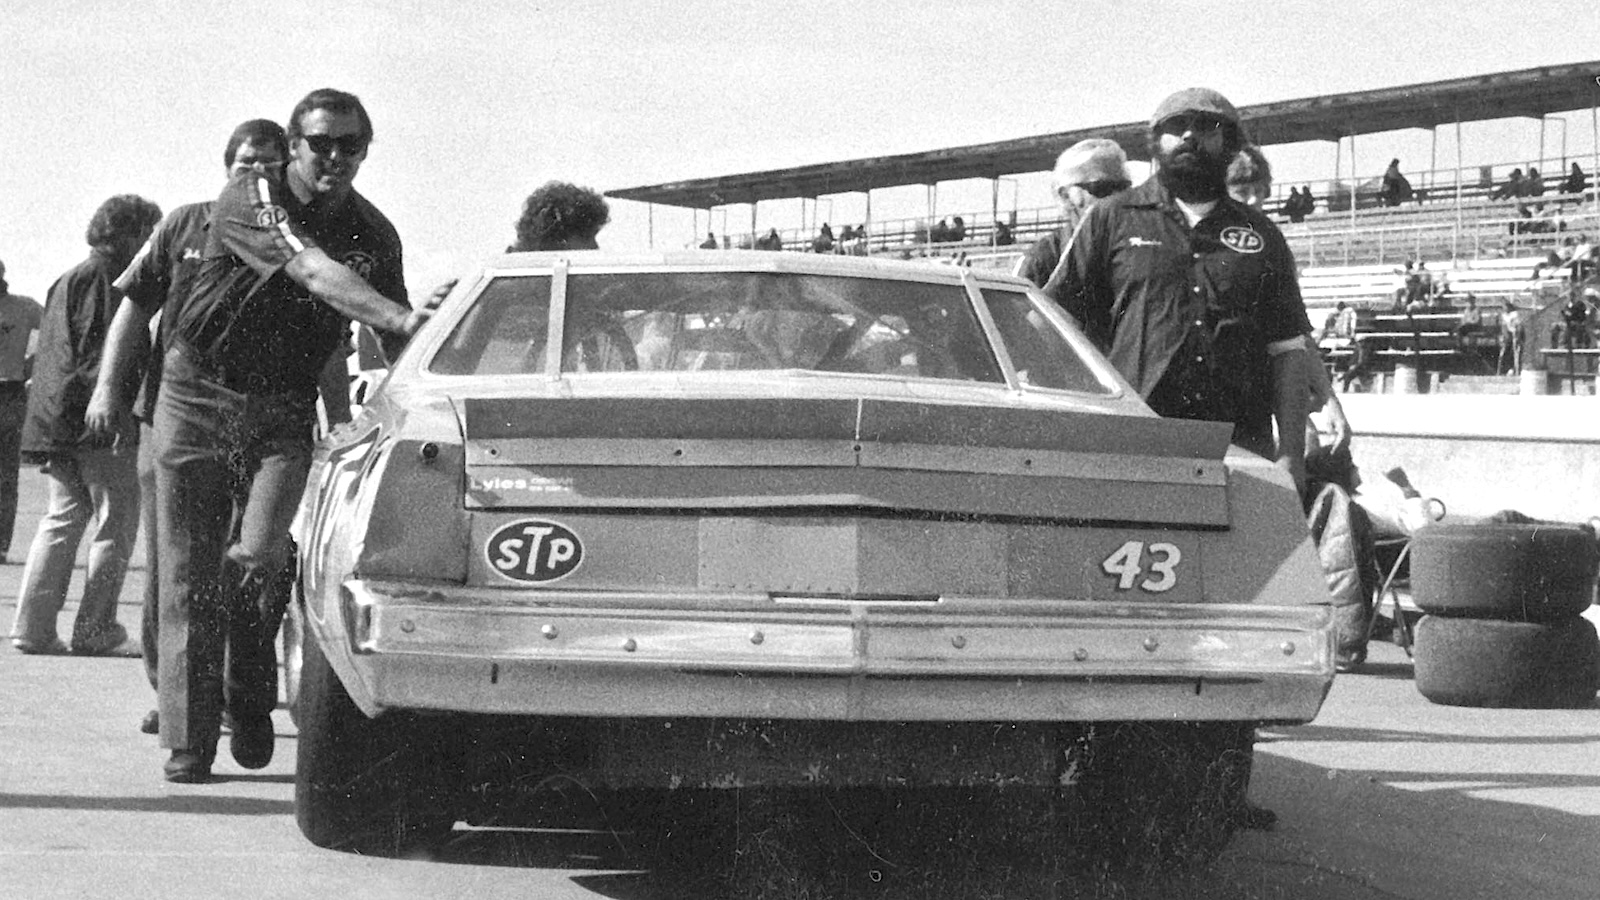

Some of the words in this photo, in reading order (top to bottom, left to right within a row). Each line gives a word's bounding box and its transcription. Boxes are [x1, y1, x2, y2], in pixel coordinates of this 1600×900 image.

[1227, 231, 1260, 248] STP
[470, 477, 527, 492] Lyles
[495, 525, 576, 576] STP
[1102, 540, 1182, 592] 43
